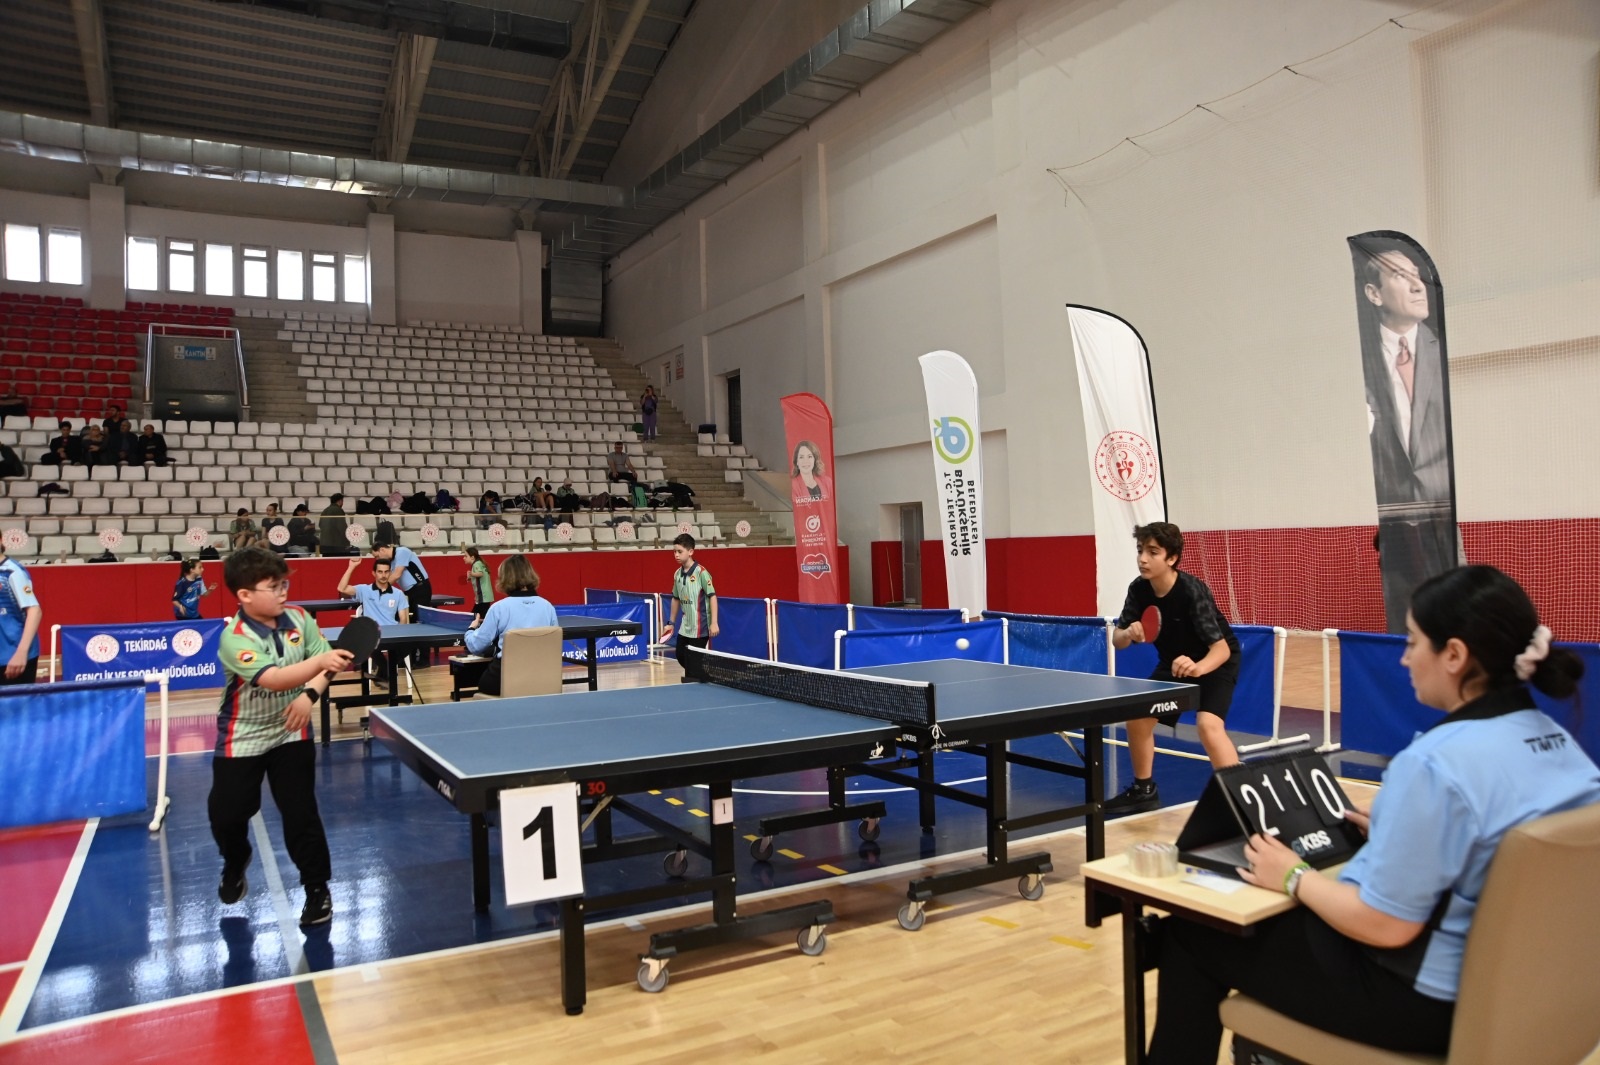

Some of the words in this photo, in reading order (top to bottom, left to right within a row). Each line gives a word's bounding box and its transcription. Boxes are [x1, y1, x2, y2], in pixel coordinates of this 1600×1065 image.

[124, 636, 168, 653] TEKİRDAĞ
[600, 644, 639, 659] MÜDÜRLÜĞÜ
[1150, 701, 1178, 714] STIGA
[948, 739, 969, 747] GERMANY
[1523, 732, 1567, 754] TMTF
[587, 781, 606, 795] 30
[523, 806, 557, 881] 1
[1298, 831, 1332, 851] KBS
